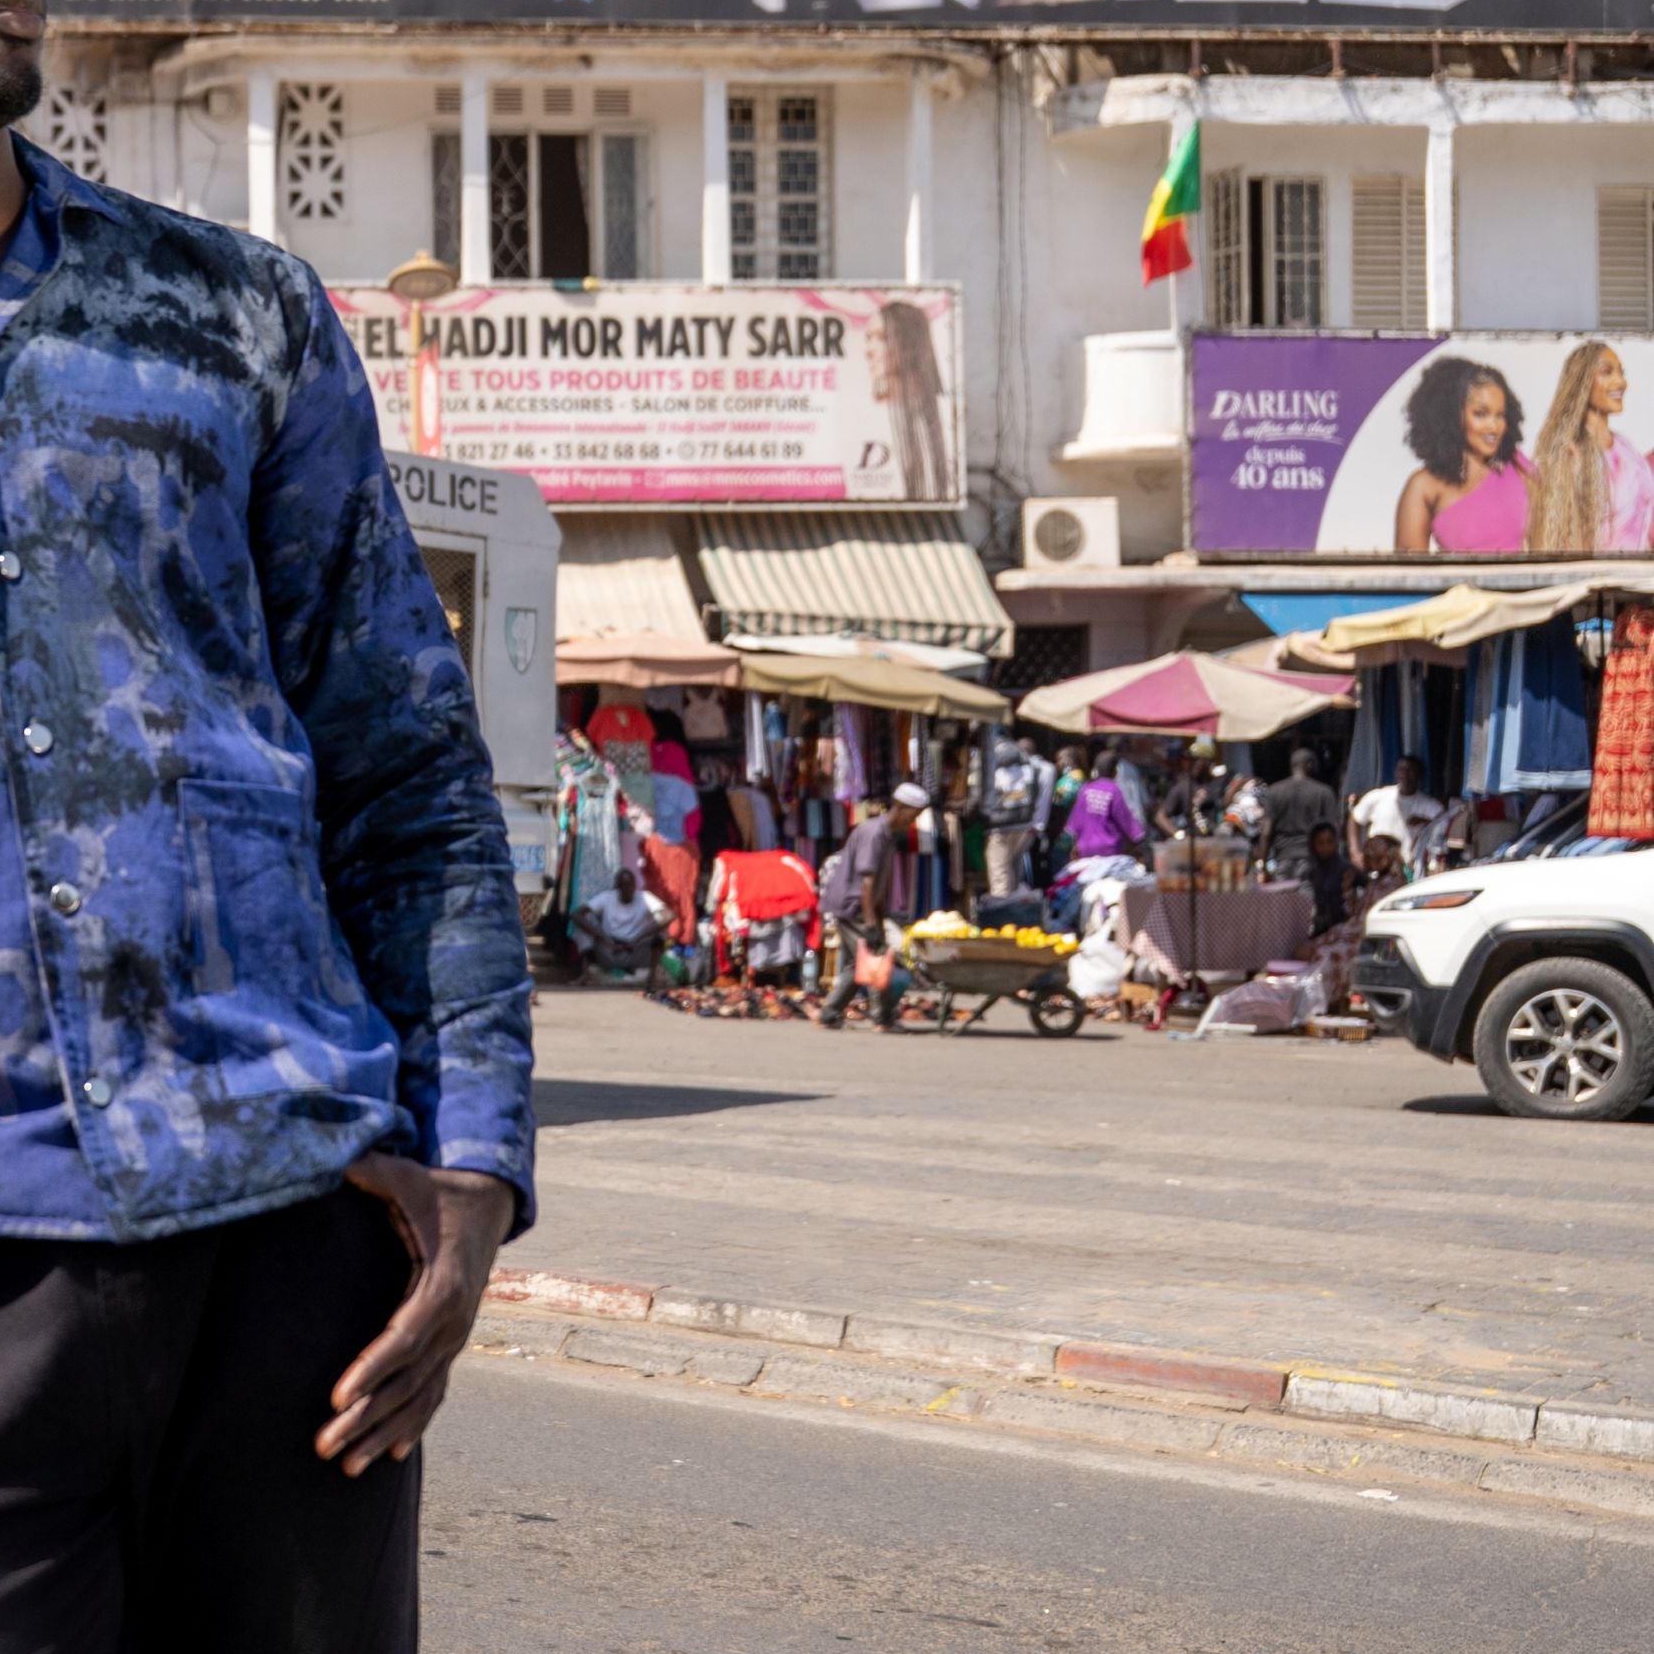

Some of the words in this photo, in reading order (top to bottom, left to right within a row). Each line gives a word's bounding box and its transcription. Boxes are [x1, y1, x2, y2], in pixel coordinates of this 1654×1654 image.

[364, 316, 404, 359] EL
[540, 316, 623, 359] MOR
[636, 316, 735, 359] MATY
[748, 316, 845, 359] SARR
[471, 370, 541, 392] TOUS
[550, 370, 683, 392] PRODUITS
[693, 370, 724, 391] DE
[735, 366, 836, 391] BEAUTÉ
[495, 398, 614, 413] ACCESSOIRES
[631, 398, 689, 413] SALON
[696, 398, 718, 412] DE
[1209, 389, 1339, 420] DARLING
[1245, 445, 1306, 468] depuis
[1229, 462, 1267, 489] 40
[1272, 465, 1325, 490] ans
